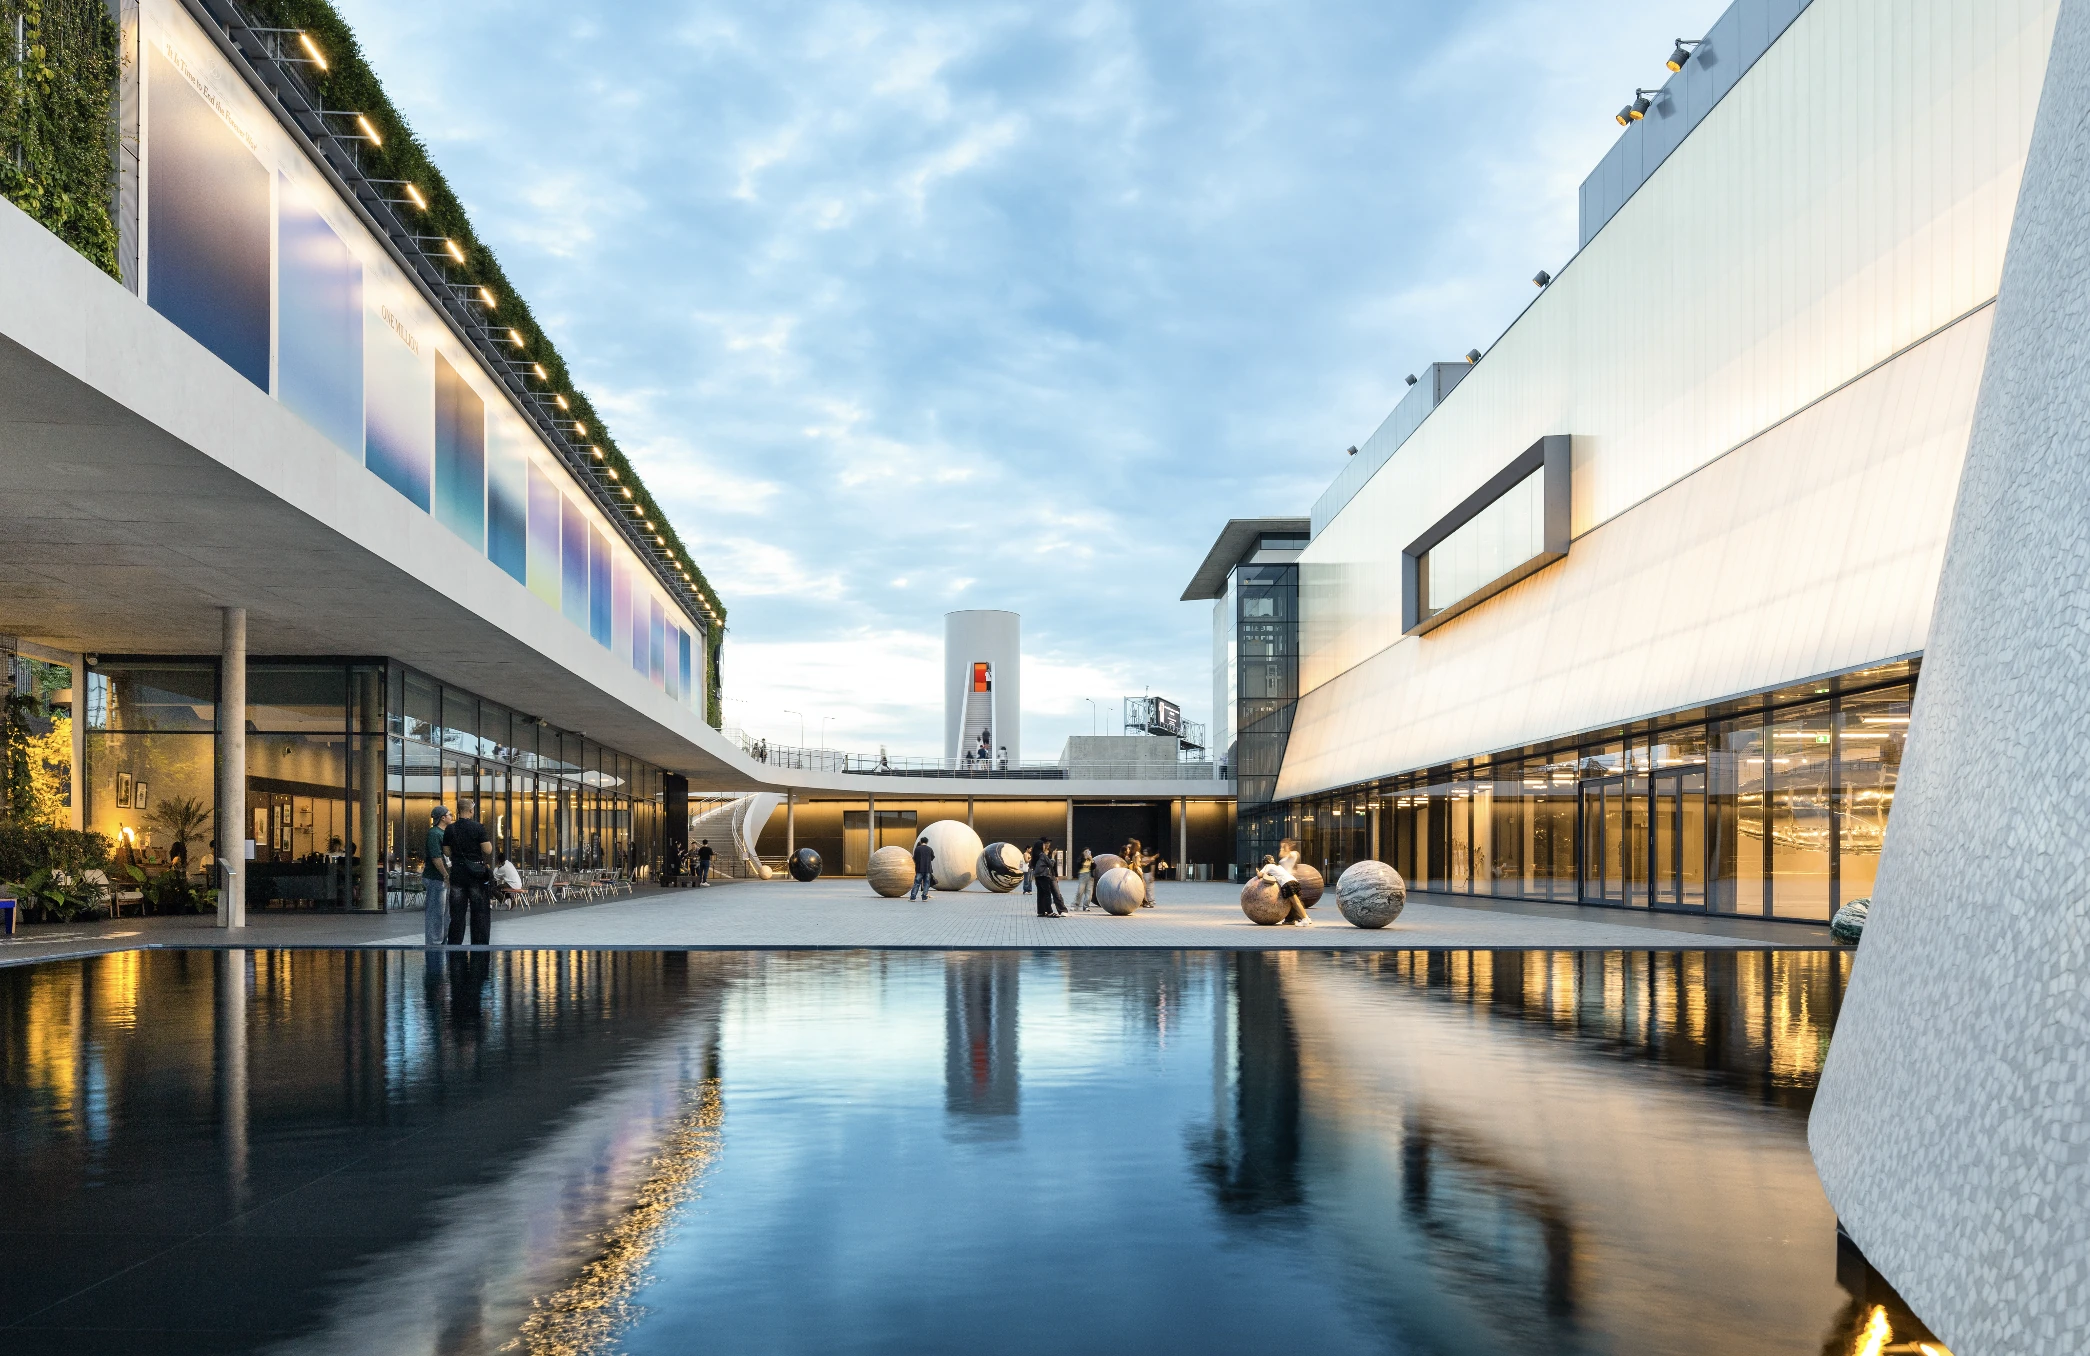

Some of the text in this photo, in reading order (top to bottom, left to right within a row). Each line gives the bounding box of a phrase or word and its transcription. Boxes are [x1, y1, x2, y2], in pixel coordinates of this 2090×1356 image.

[181, 59, 196, 84] Time
[196, 79, 203, 91] to
[203, 85, 215, 106] End
[215, 101, 224, 116] the
[225, 110, 245, 138] Forever
[381, 304, 394, 329] ONE
[395, 317, 419, 355] MILLION
